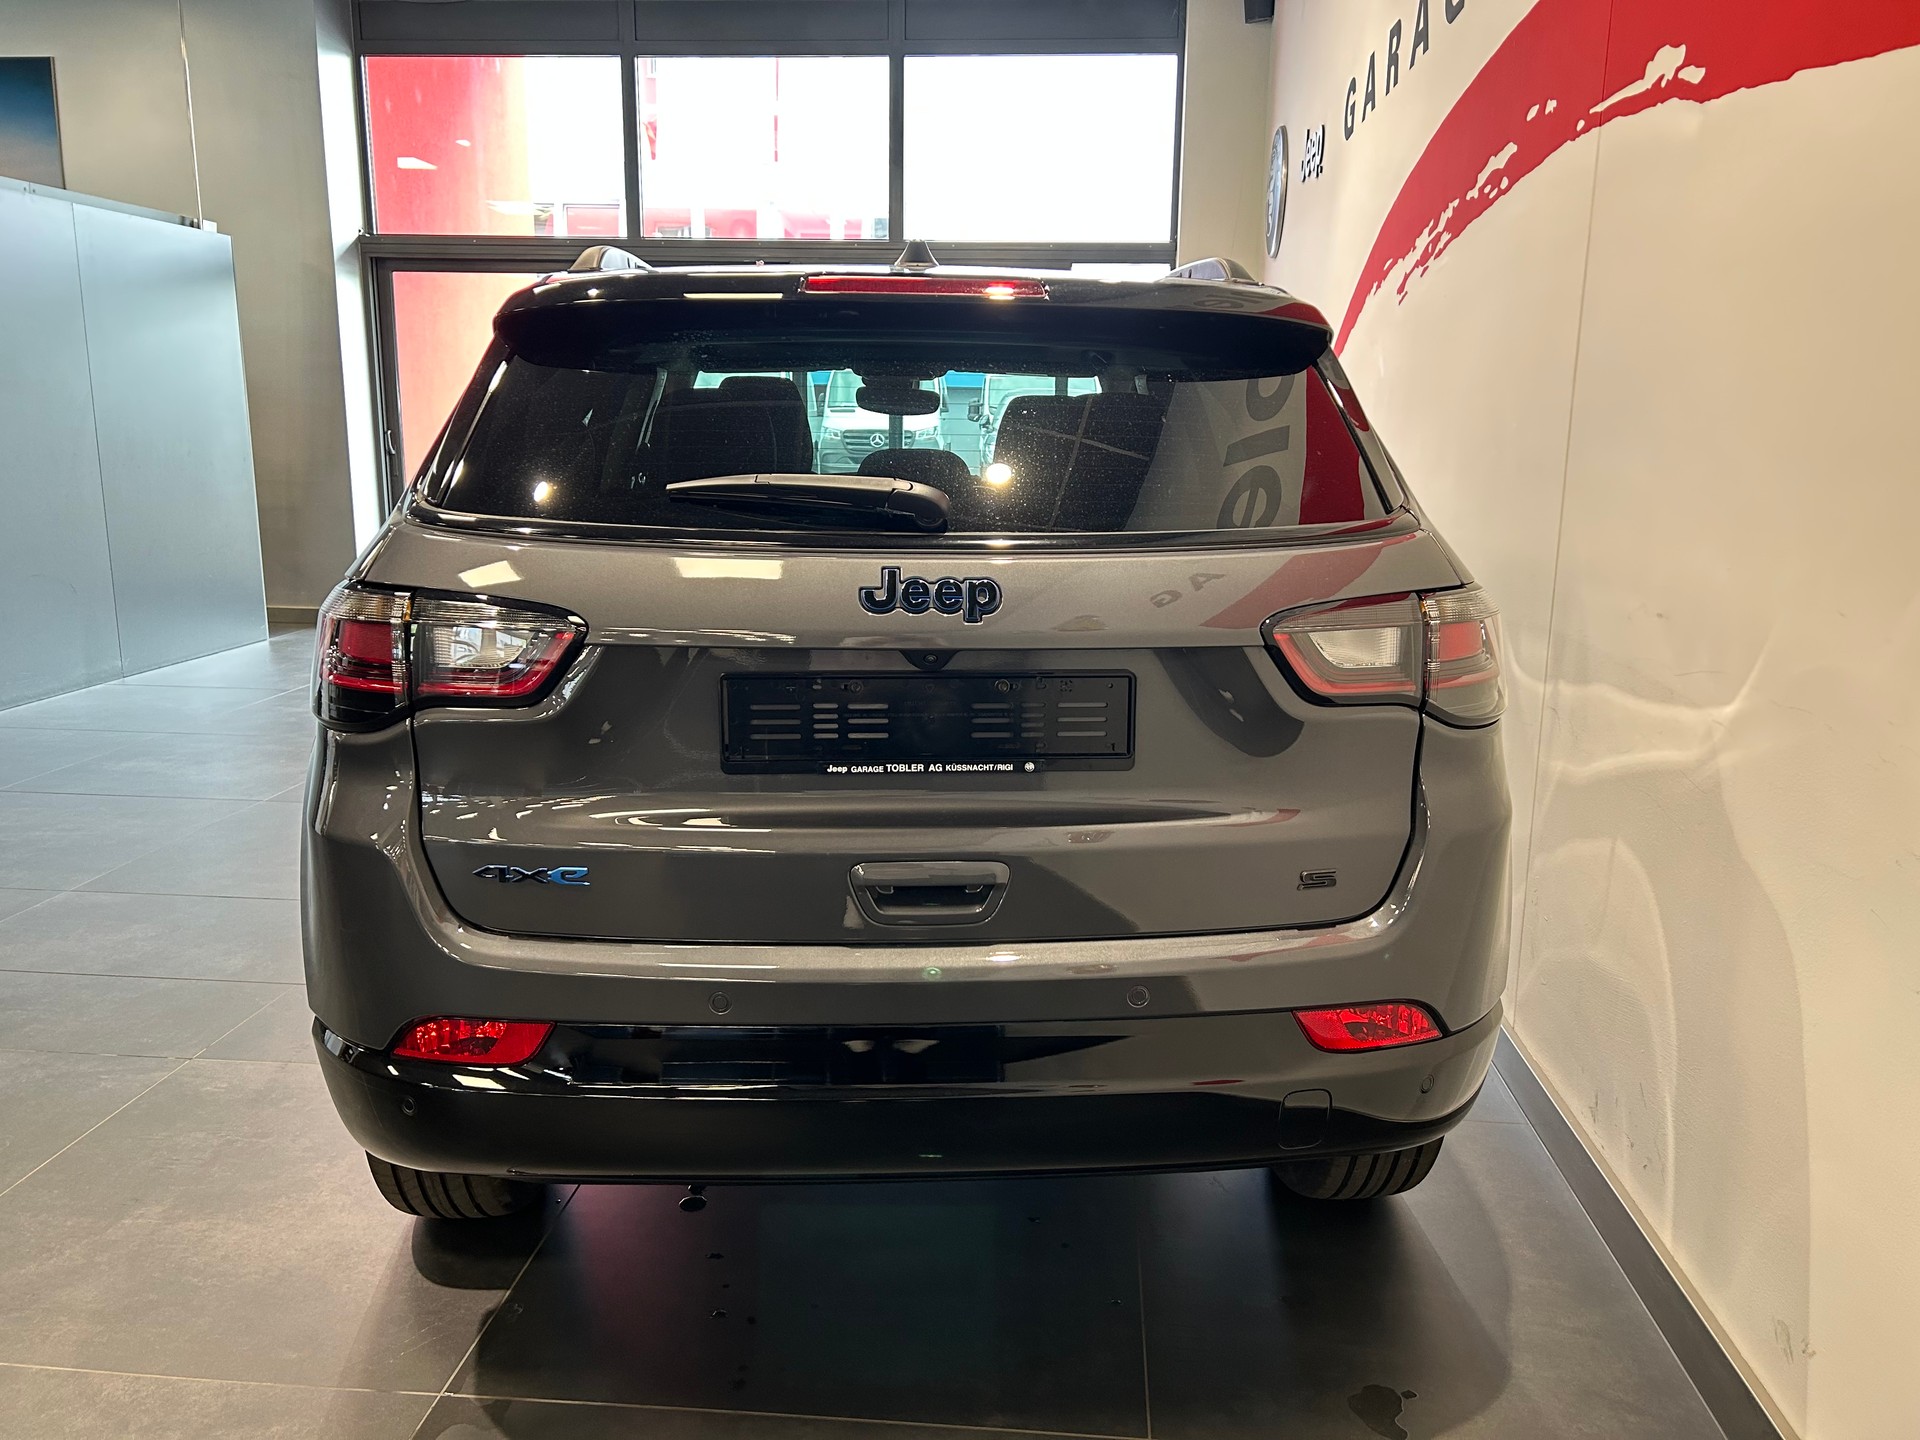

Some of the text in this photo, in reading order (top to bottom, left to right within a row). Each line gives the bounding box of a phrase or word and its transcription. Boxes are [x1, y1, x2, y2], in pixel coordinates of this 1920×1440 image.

[1300, 123, 1326, 183] Jeep
[858, 565, 1004, 626] Jeep
[826, 762, 1014, 774] Jeep GARAGE TOBLER AG KÜSSNACHT/RIGI
[1296, 868, 1337, 891] S
